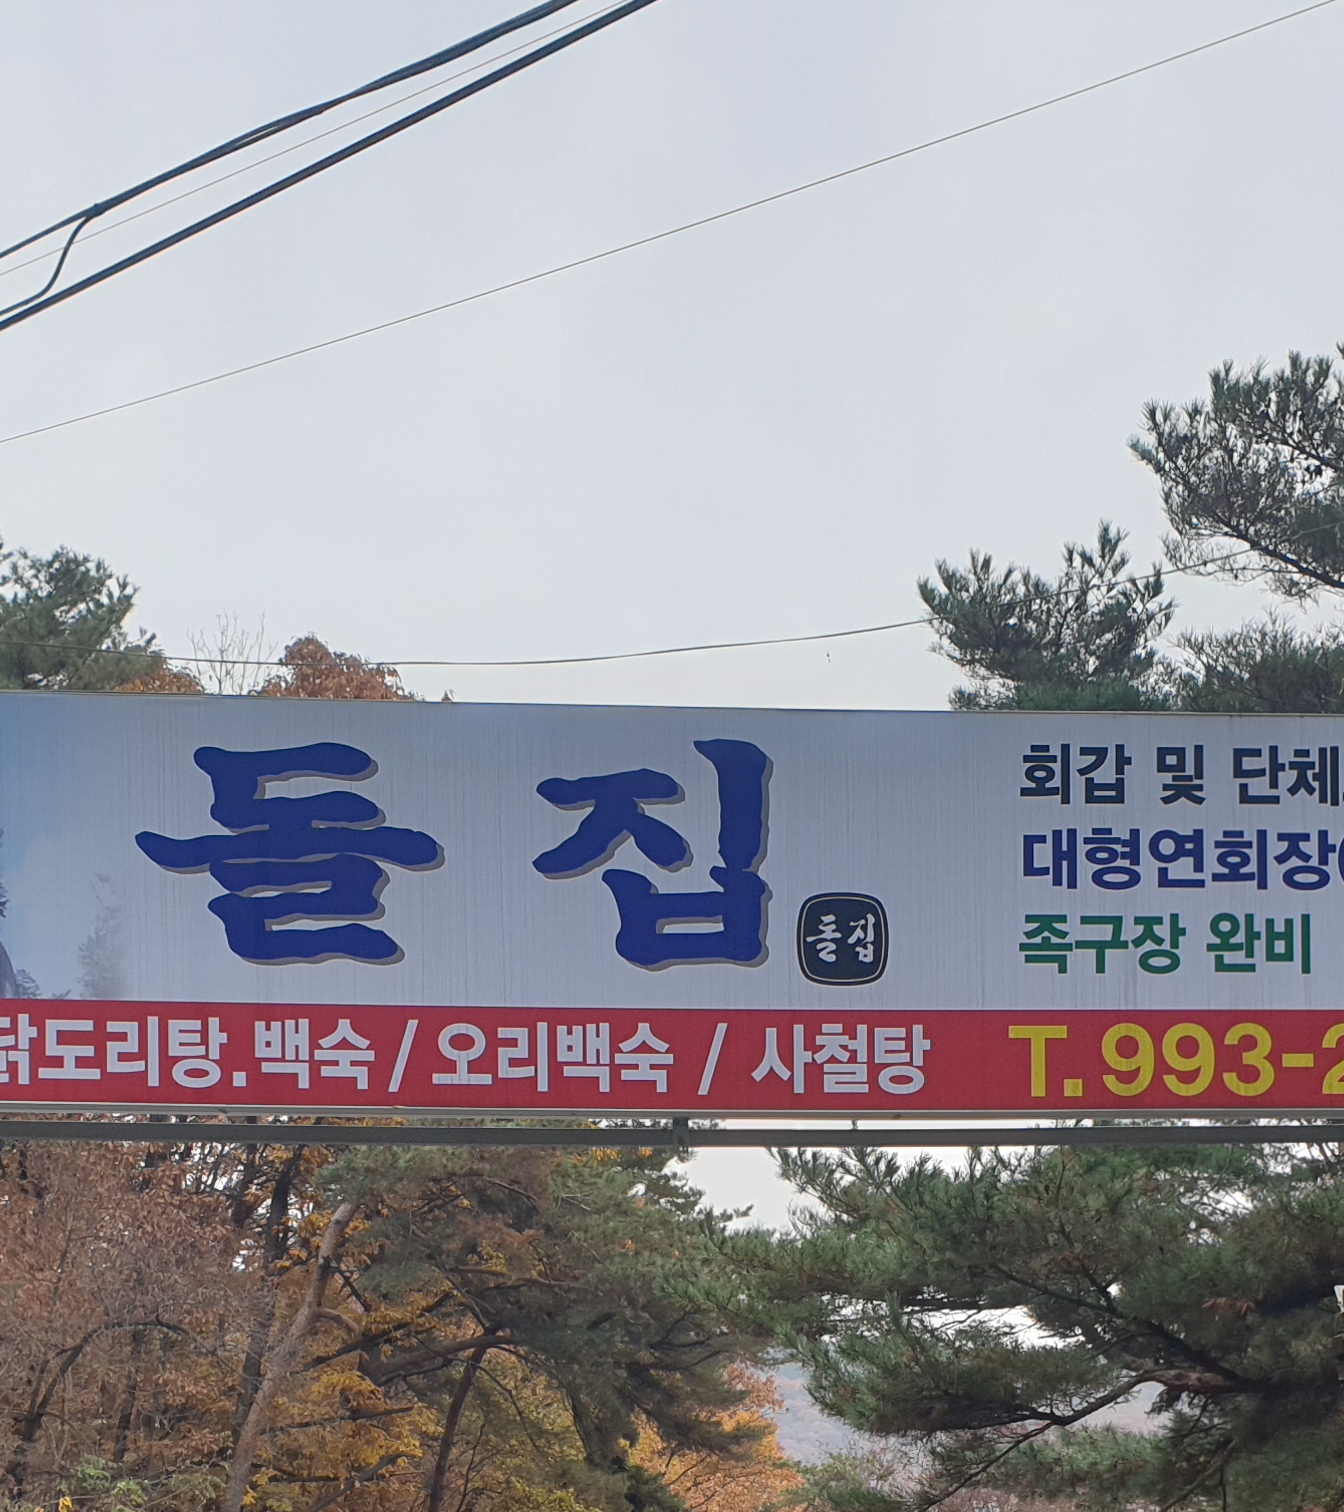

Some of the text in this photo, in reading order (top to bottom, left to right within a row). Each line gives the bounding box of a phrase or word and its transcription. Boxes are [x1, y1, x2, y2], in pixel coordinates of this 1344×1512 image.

[1020, 743, 1131, 806] 회갑
[1156, 744, 1206, 806] 및
[135, 740, 773, 972] 돌집
[805, 913, 876, 963] 돌집
[1019, 912, 1311, 974] 족구장 완비
[432, 1021, 674, 1093] 오리백숙
[751, 1023, 931, 1095] 사철탕
